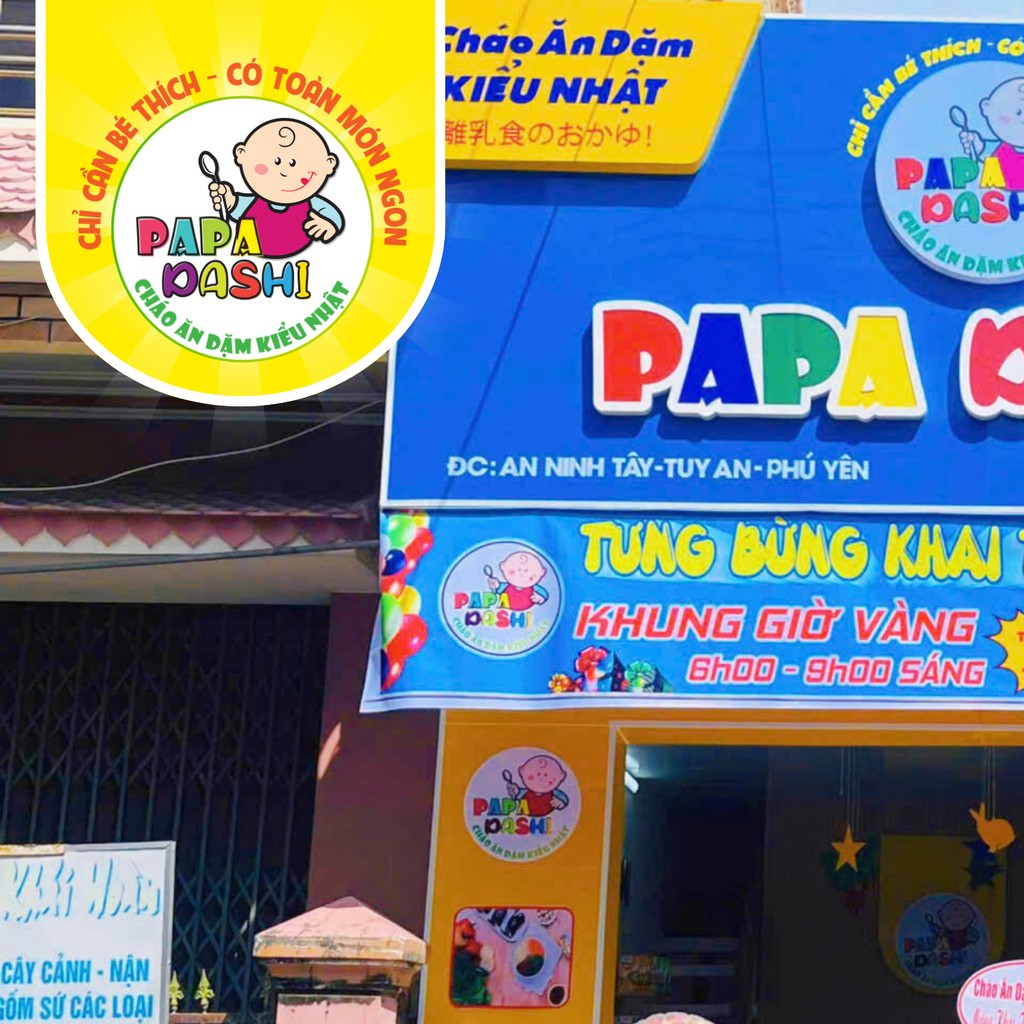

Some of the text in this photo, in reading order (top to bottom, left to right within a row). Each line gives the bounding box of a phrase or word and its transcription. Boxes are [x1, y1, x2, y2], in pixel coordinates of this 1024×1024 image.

[537, 18, 596, 55] Ăn
[600, 28, 694, 66] Dặm
[445, 59, 668, 113] KIỂU NHẬT
[895, 157, 1007, 190] PAPA
[594, 302, 926, 420] PAPA
[545, 457, 605, 478] NINH
[821, 455, 870, 481] YÊN
[730, 517, 869, 580] BỪNG
[883, 523, 1001, 582] KHAI
[454, 592, 511, 609] PAPA
[574, 602, 741, 642] KHUNG
[753, 600, 842, 643] GIỜ
[855, 600, 978, 645] VÀNG
[686, 652, 986, 687] 6h00 9h00 SÁNG
[473, 798, 530, 816] PAPA
[484, 817, 552, 835] DASHI
[2, 957, 37, 985] CÂY
[41, 952, 92, 984] CẢNH
[974, 978, 998, 999] Cháo
[40, 991, 66, 1020] SỨ
[70, 989, 107, 1019] CÁC
[112, 994, 155, 1024] LOẠI
